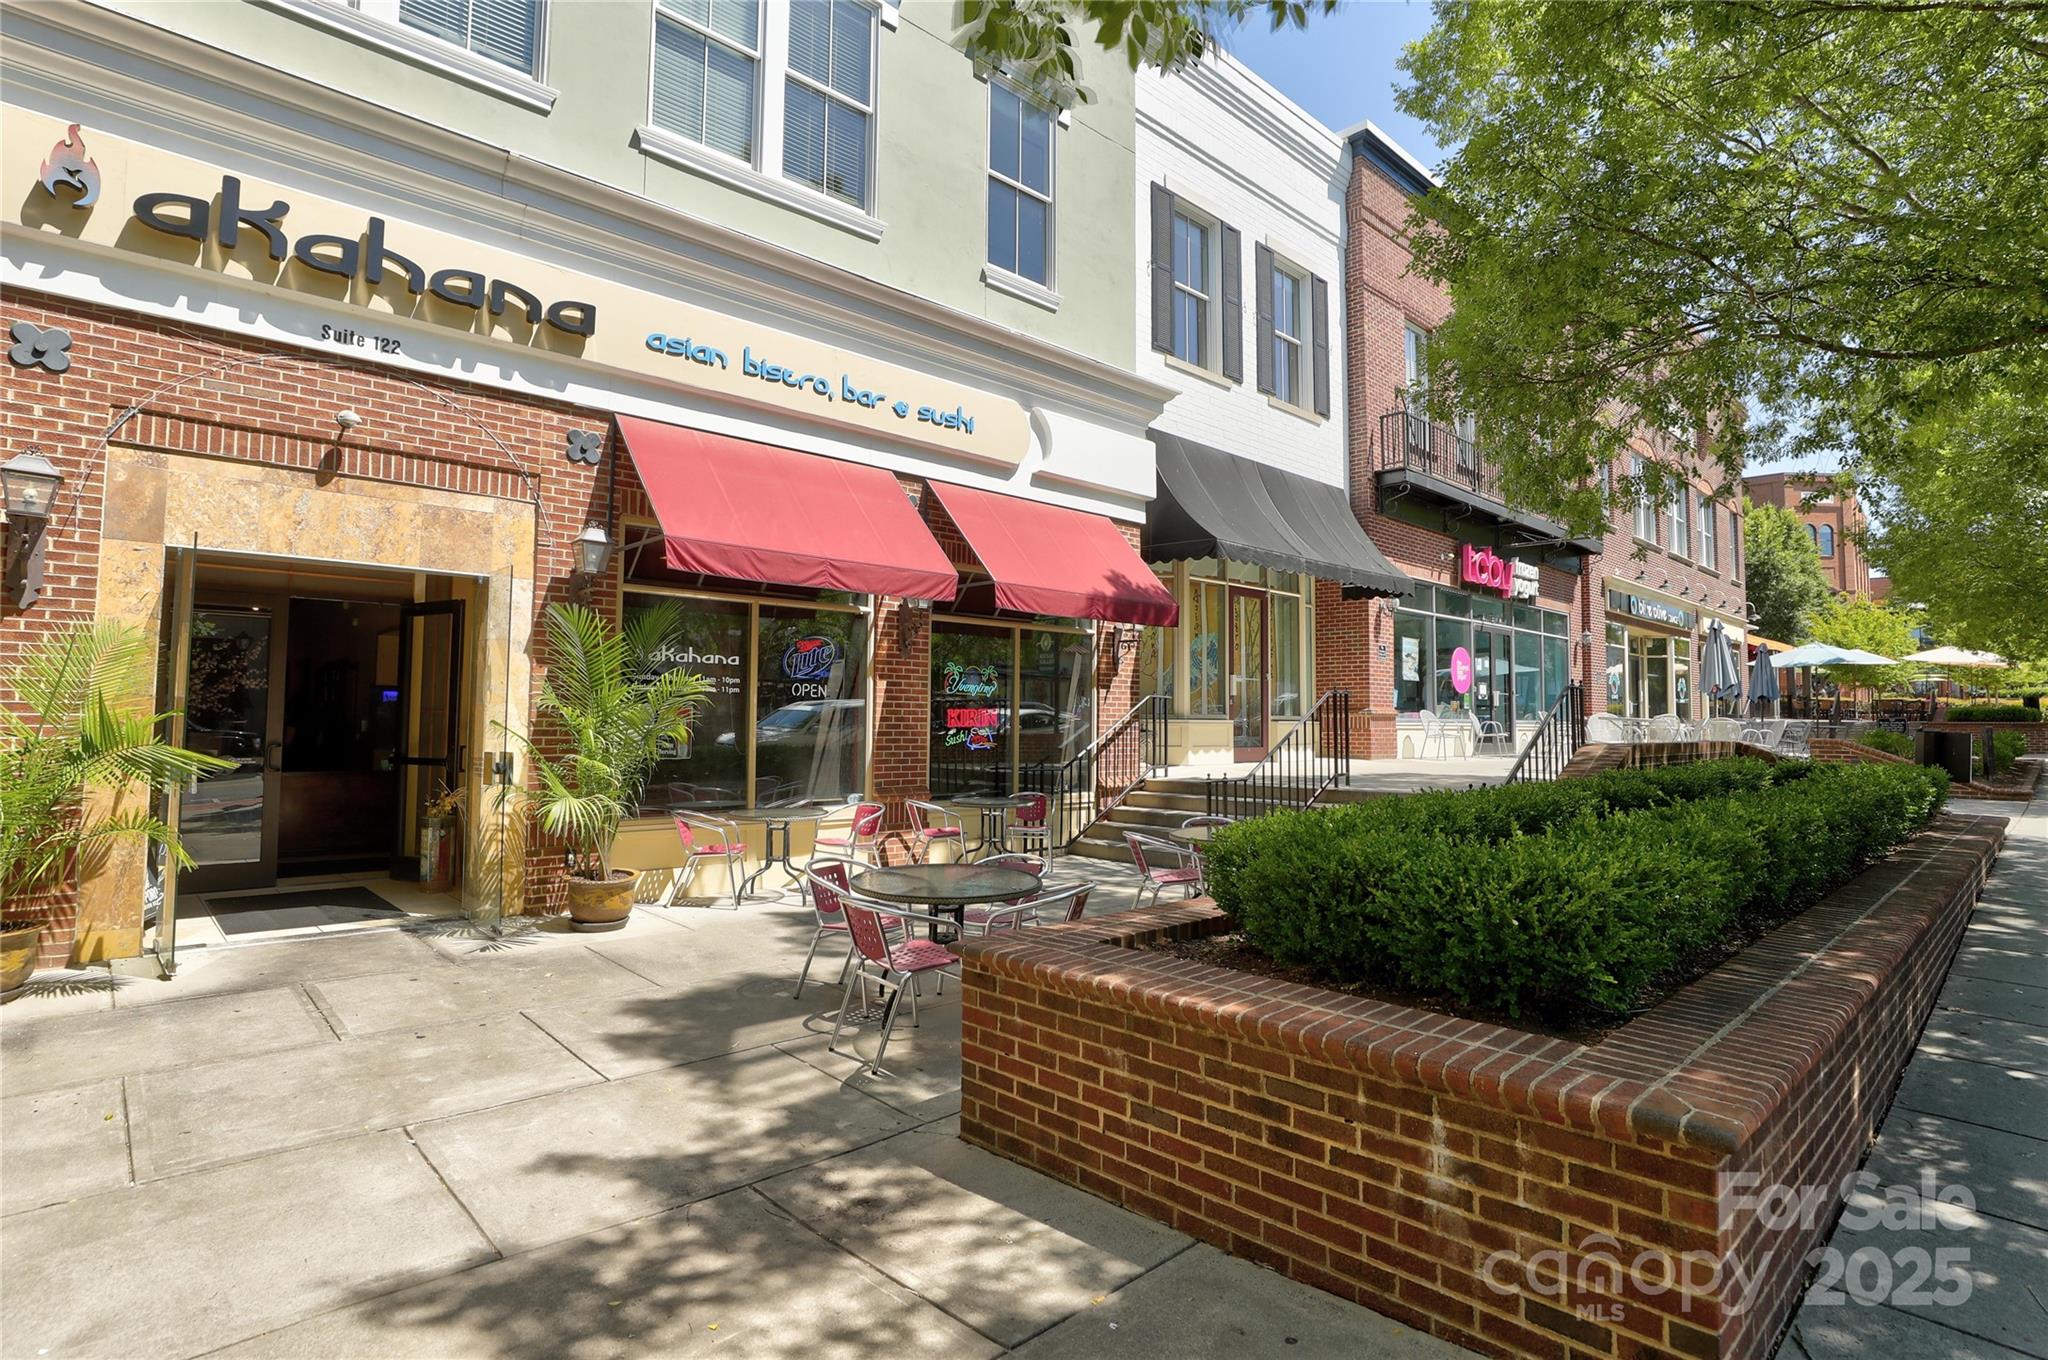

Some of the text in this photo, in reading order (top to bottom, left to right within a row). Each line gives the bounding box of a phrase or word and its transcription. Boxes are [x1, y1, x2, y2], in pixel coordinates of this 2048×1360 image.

[321, 324, 401, 355] Suite 122
[645, 332, 729, 370] asian
[841, 374, 886, 409] bar
[917, 406, 975, 435] sushi
[721, 676, 741, 685] 10pm
[791, 682, 828, 698] OPEN
[721, 686, 740, 695] 11pm
[947, 707, 999, 729] KIRIN
